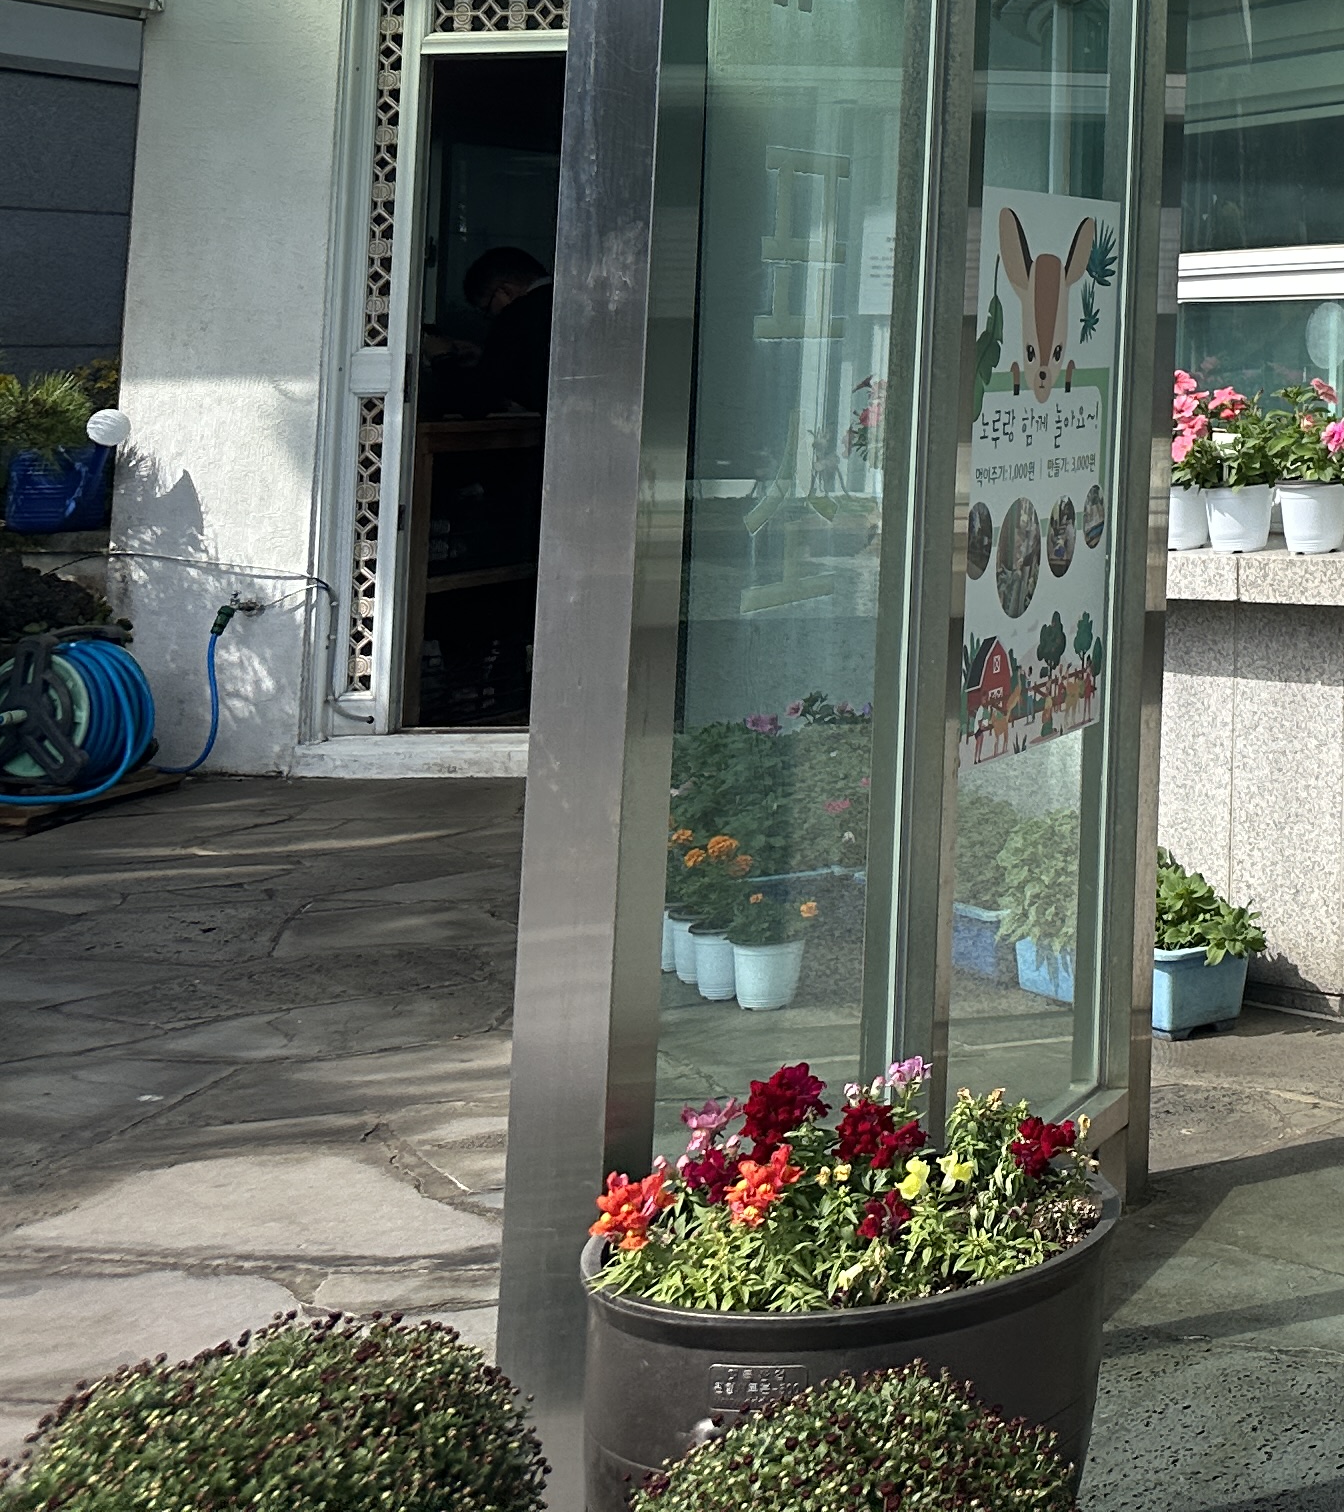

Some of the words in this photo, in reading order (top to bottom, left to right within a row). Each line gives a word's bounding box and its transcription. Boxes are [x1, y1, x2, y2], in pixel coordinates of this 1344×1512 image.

[980, 408, 1016, 449] 노루랑
[1022, 407, 1049, 448] 함께
[1053, 400, 1100, 449] 놀아요~!
